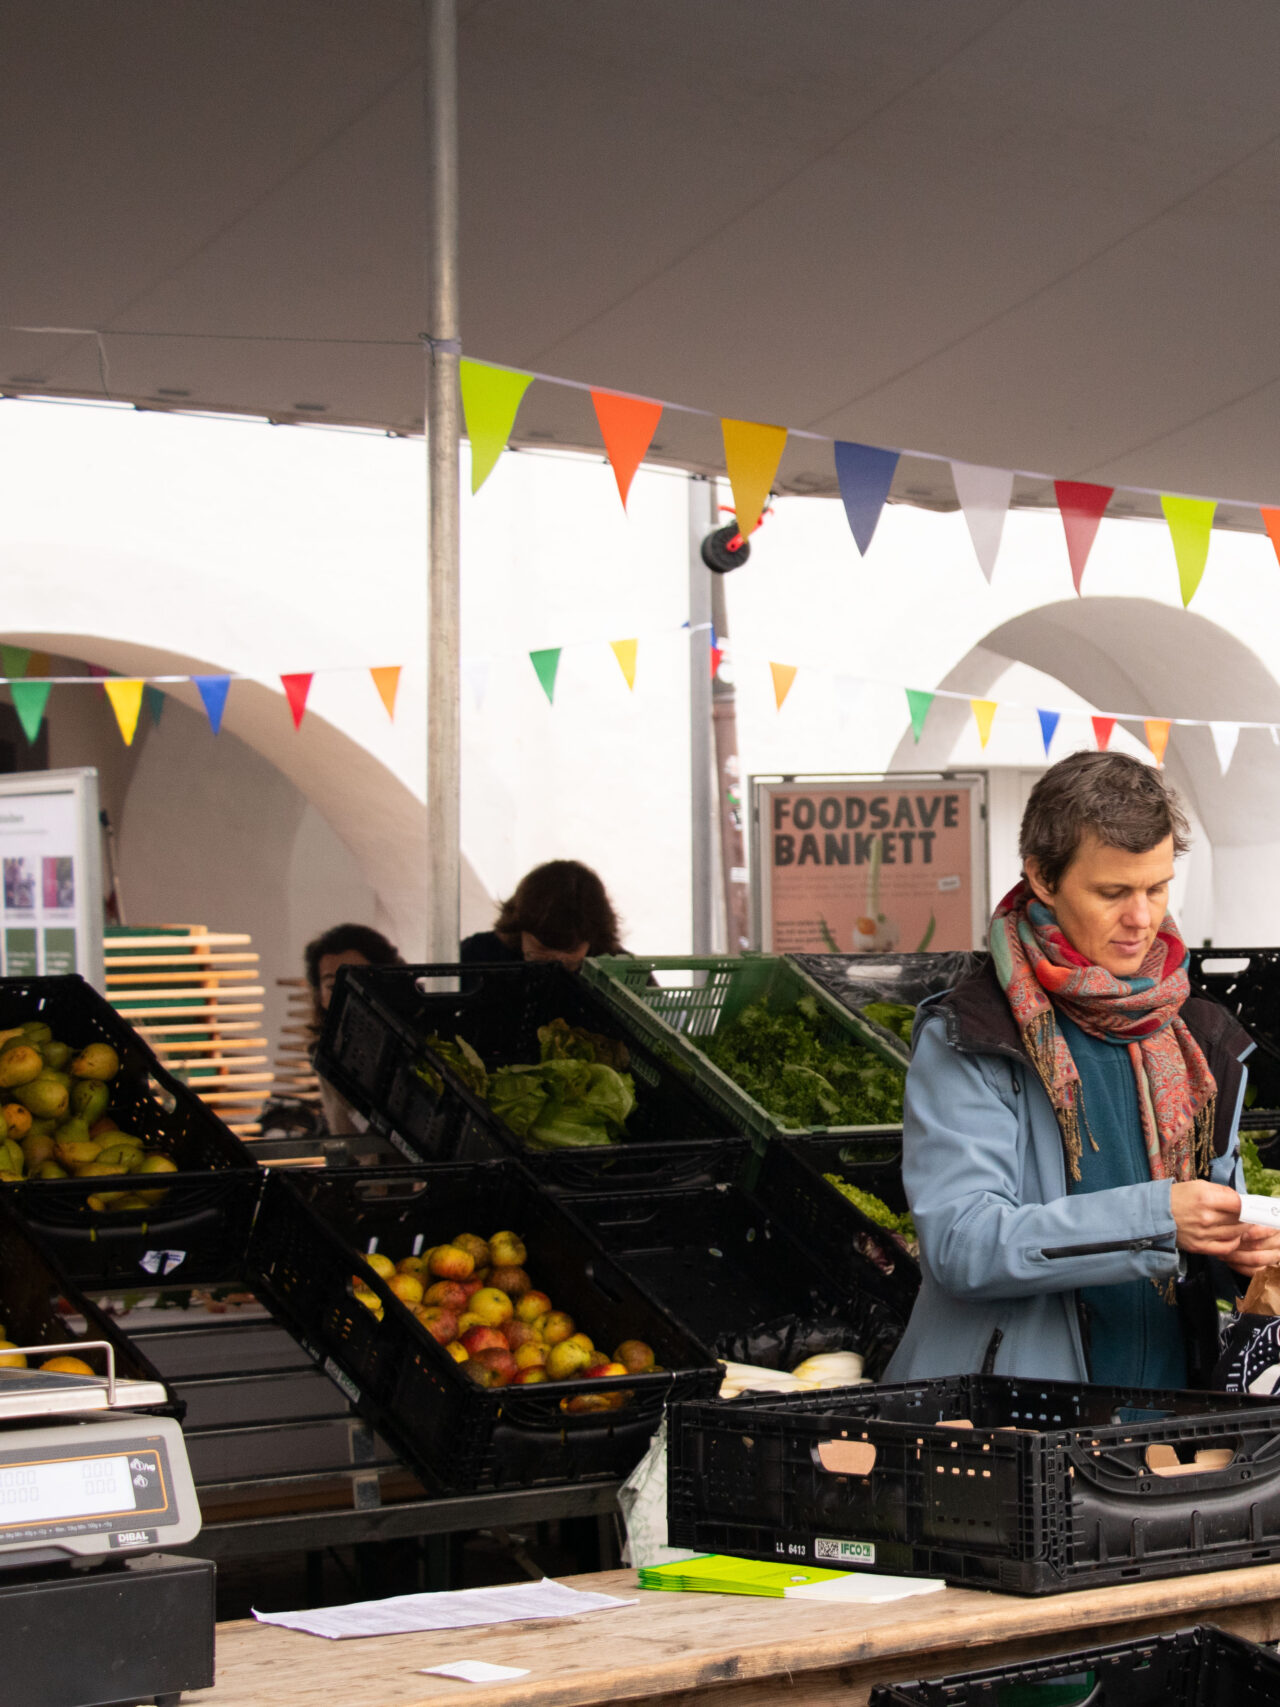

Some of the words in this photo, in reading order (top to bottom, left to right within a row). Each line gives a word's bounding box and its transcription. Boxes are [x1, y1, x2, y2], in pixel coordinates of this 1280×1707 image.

[774, 794, 959, 830] FOODSAVE
[774, 830, 936, 866] BANKETT
[117, 1531, 149, 1544] DIBAL
[788, 1543, 806, 1556] 6413
[841, 1543, 862, 1555] IFCO
